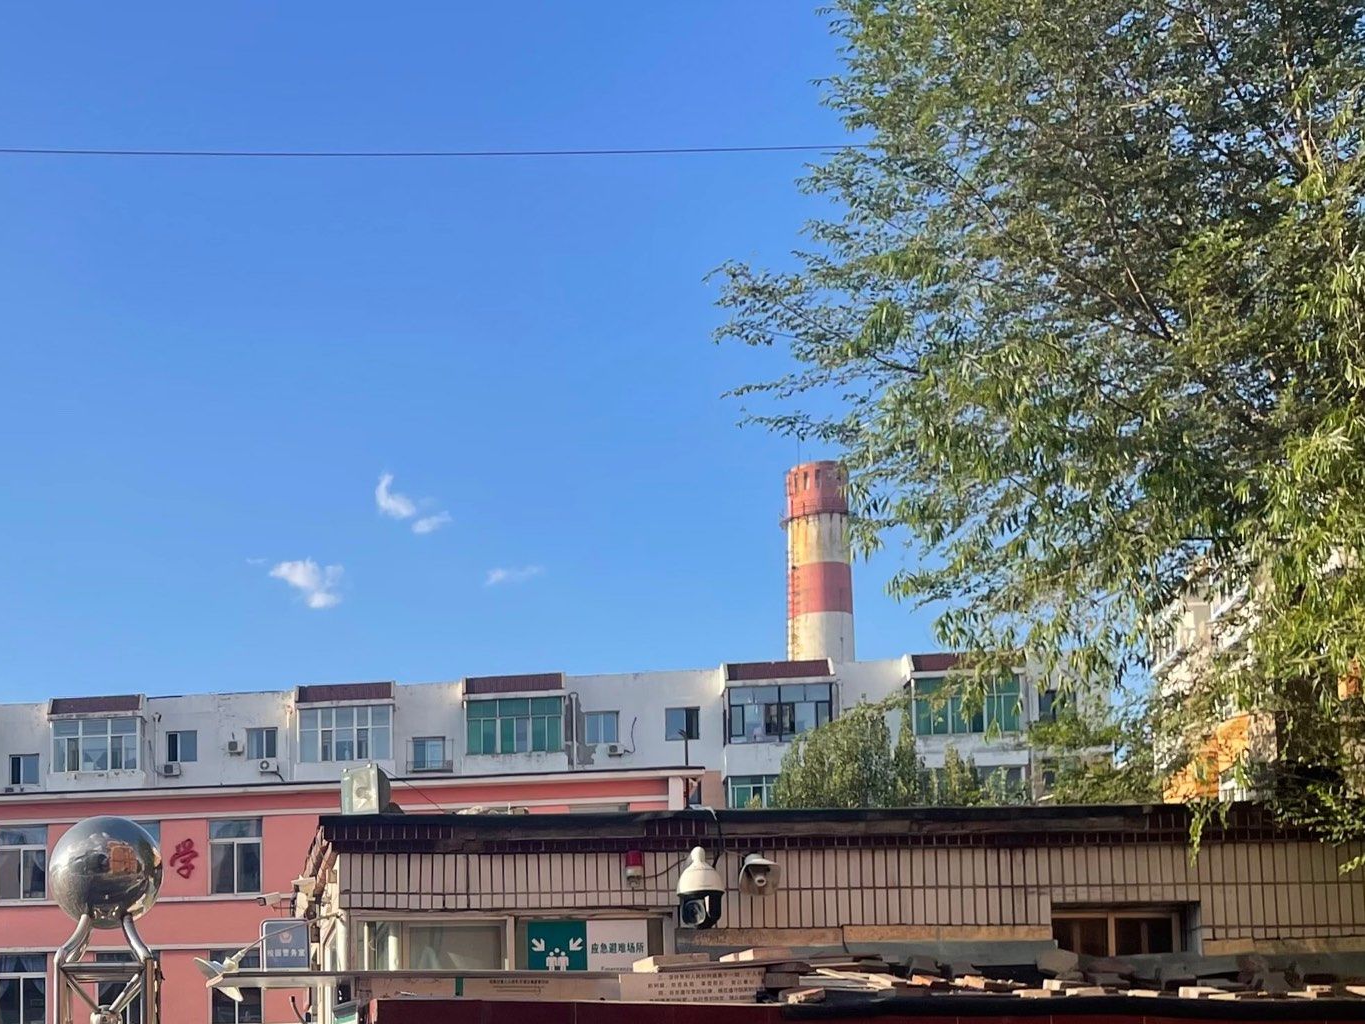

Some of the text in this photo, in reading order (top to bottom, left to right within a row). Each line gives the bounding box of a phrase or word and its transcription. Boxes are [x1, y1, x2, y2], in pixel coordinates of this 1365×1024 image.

[170, 838, 199, 879] 学
[591, 943, 644, 954] 应急避难场所
